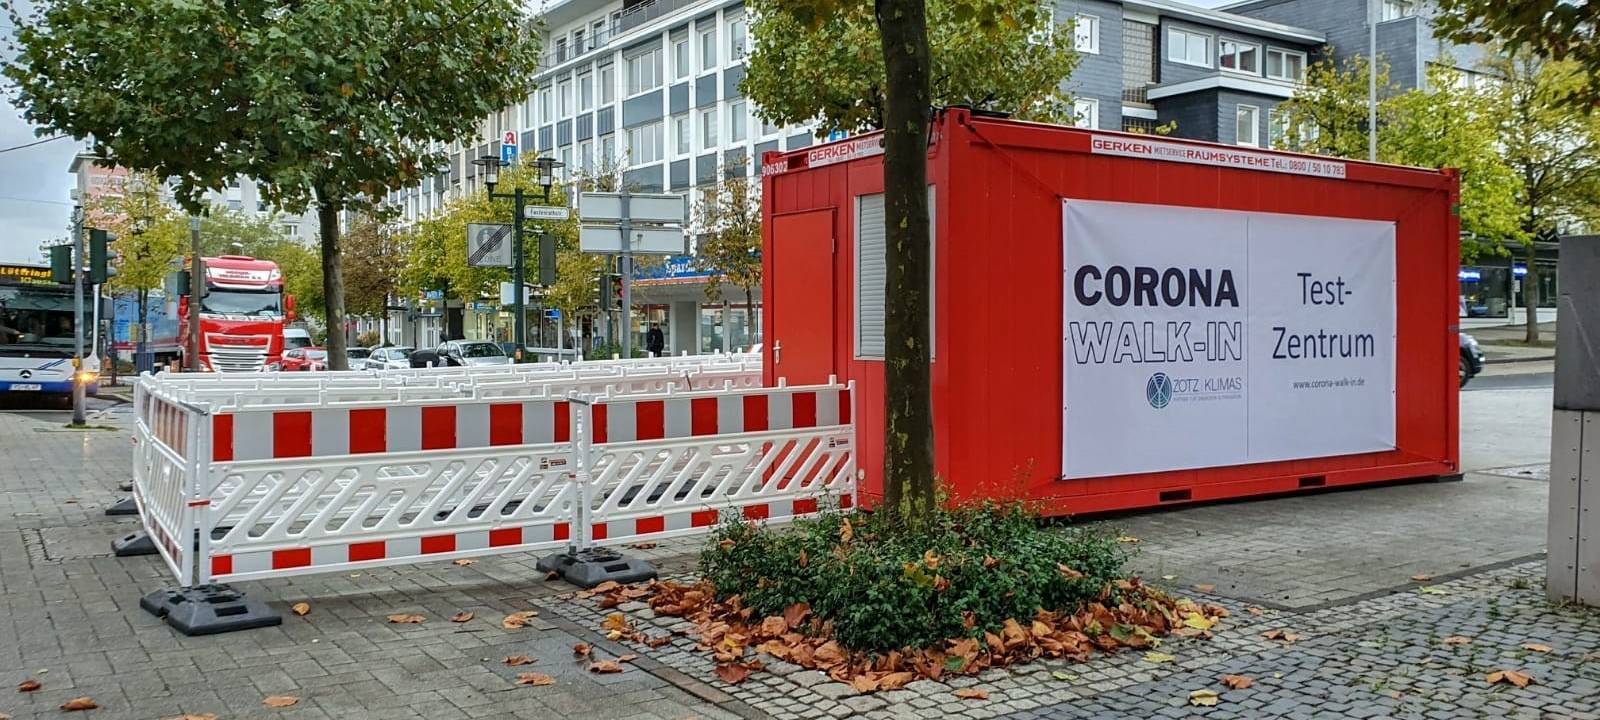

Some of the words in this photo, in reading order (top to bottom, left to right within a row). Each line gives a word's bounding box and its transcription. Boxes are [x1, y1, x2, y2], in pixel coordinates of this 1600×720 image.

[761, 160, 788, 177] 906302
[809, 142, 855, 162] GERKEN
[1092, 139, 1152, 154] GERKEN
[1187, 149, 1270, 167] RAUMSYSTEME
[1289, 160, 1307, 171] 0800
[1322, 163, 1332, 174] 10
[1073, 264, 1239, 307] CORONA
[1296, 272, 1353, 305] Test-
[1069, 321, 1242, 364] WALK-IN
[1272, 326, 1375, 360] Zentrum
[1173, 378, 1200, 393] ZOTZ
[1204, 377, 1242, 392] KLIMAS
[1293, 377, 1365, 389] www.corona-walk-in.de
